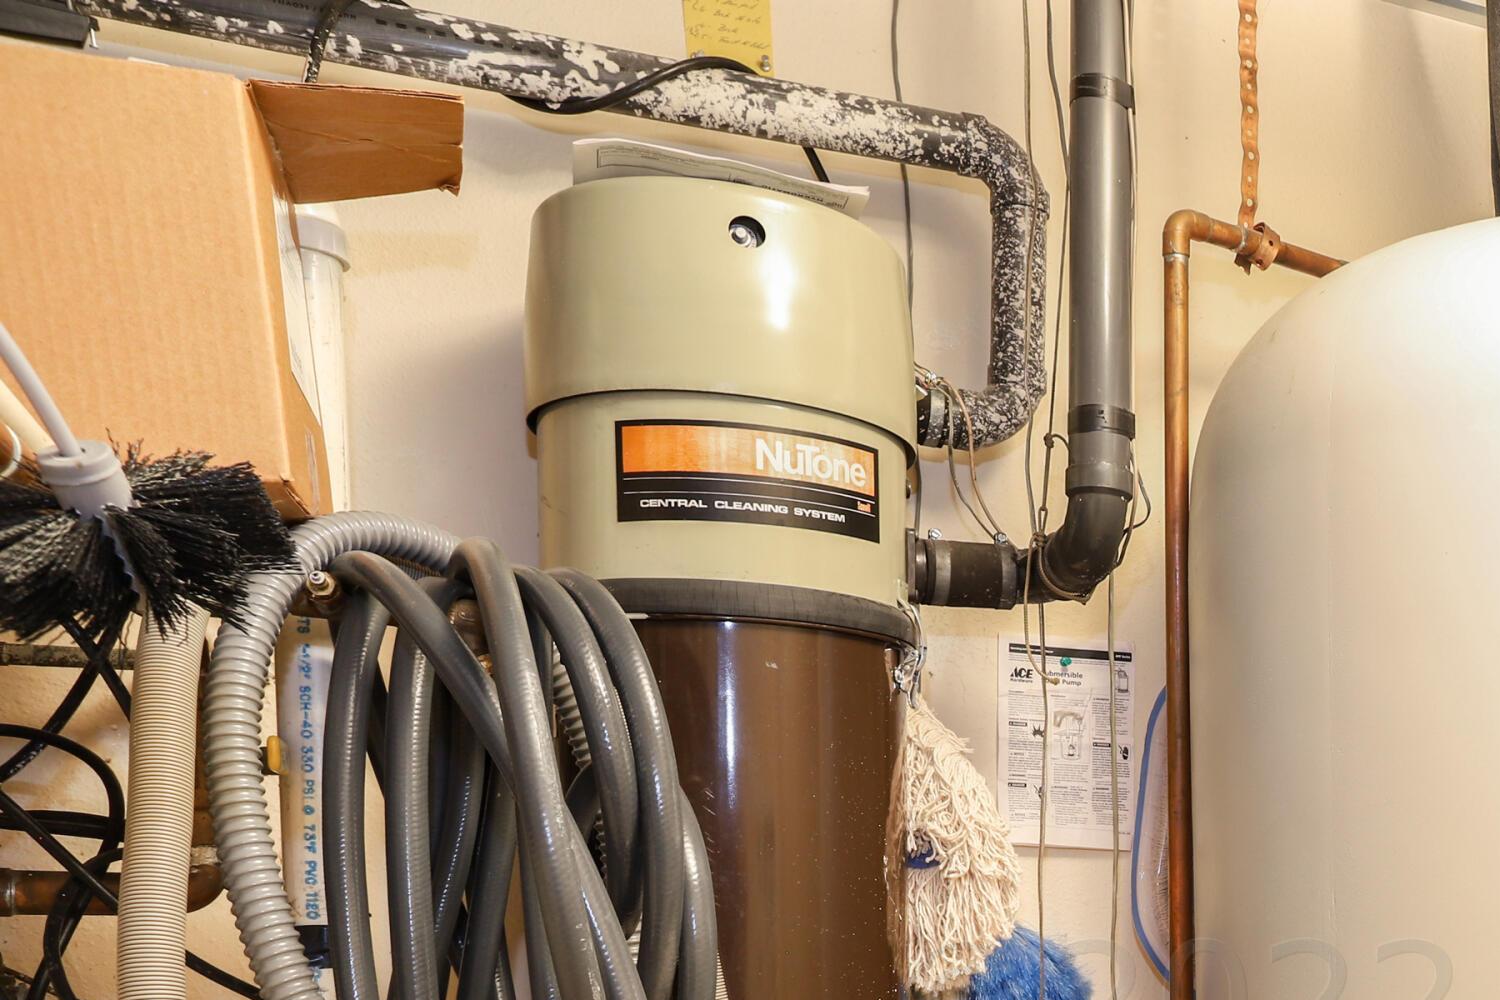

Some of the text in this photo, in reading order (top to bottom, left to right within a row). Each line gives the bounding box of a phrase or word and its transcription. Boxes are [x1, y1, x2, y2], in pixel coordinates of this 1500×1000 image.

[755, 438, 867, 487] NuTone
[639, 497, 846, 523] CENTRAL CLEANING SYSTEM
[1010, 666, 1083, 680] ACE ubmersible
[1062, 679, 1082, 687] Pump
[304, 860, 318, 886] PVC
